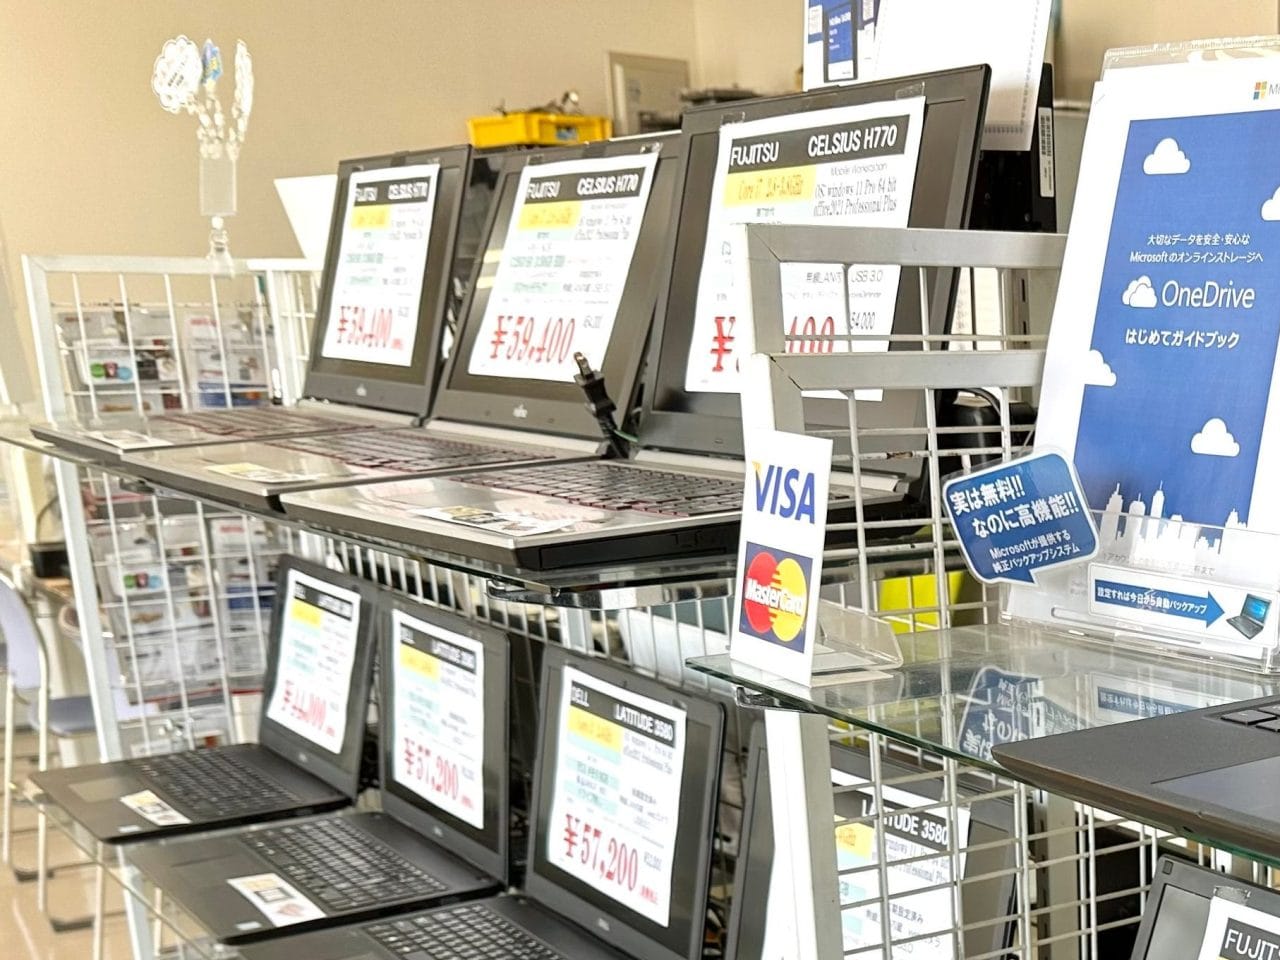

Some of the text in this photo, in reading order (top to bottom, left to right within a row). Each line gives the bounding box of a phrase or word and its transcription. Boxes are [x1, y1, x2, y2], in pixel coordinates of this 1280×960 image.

[730, 124, 898, 166] FUJITSU CELSIUS H770
[1162, 280, 1255, 308] OneDrive
[1125, 329, 1239, 348] はじめてガイドブック
[752, 461, 815, 524] VISA
[745, 578, 806, 617] MasterCard
[921, 820, 948, 844] 3580
[564, 814, 638, 892] ¥57,200
